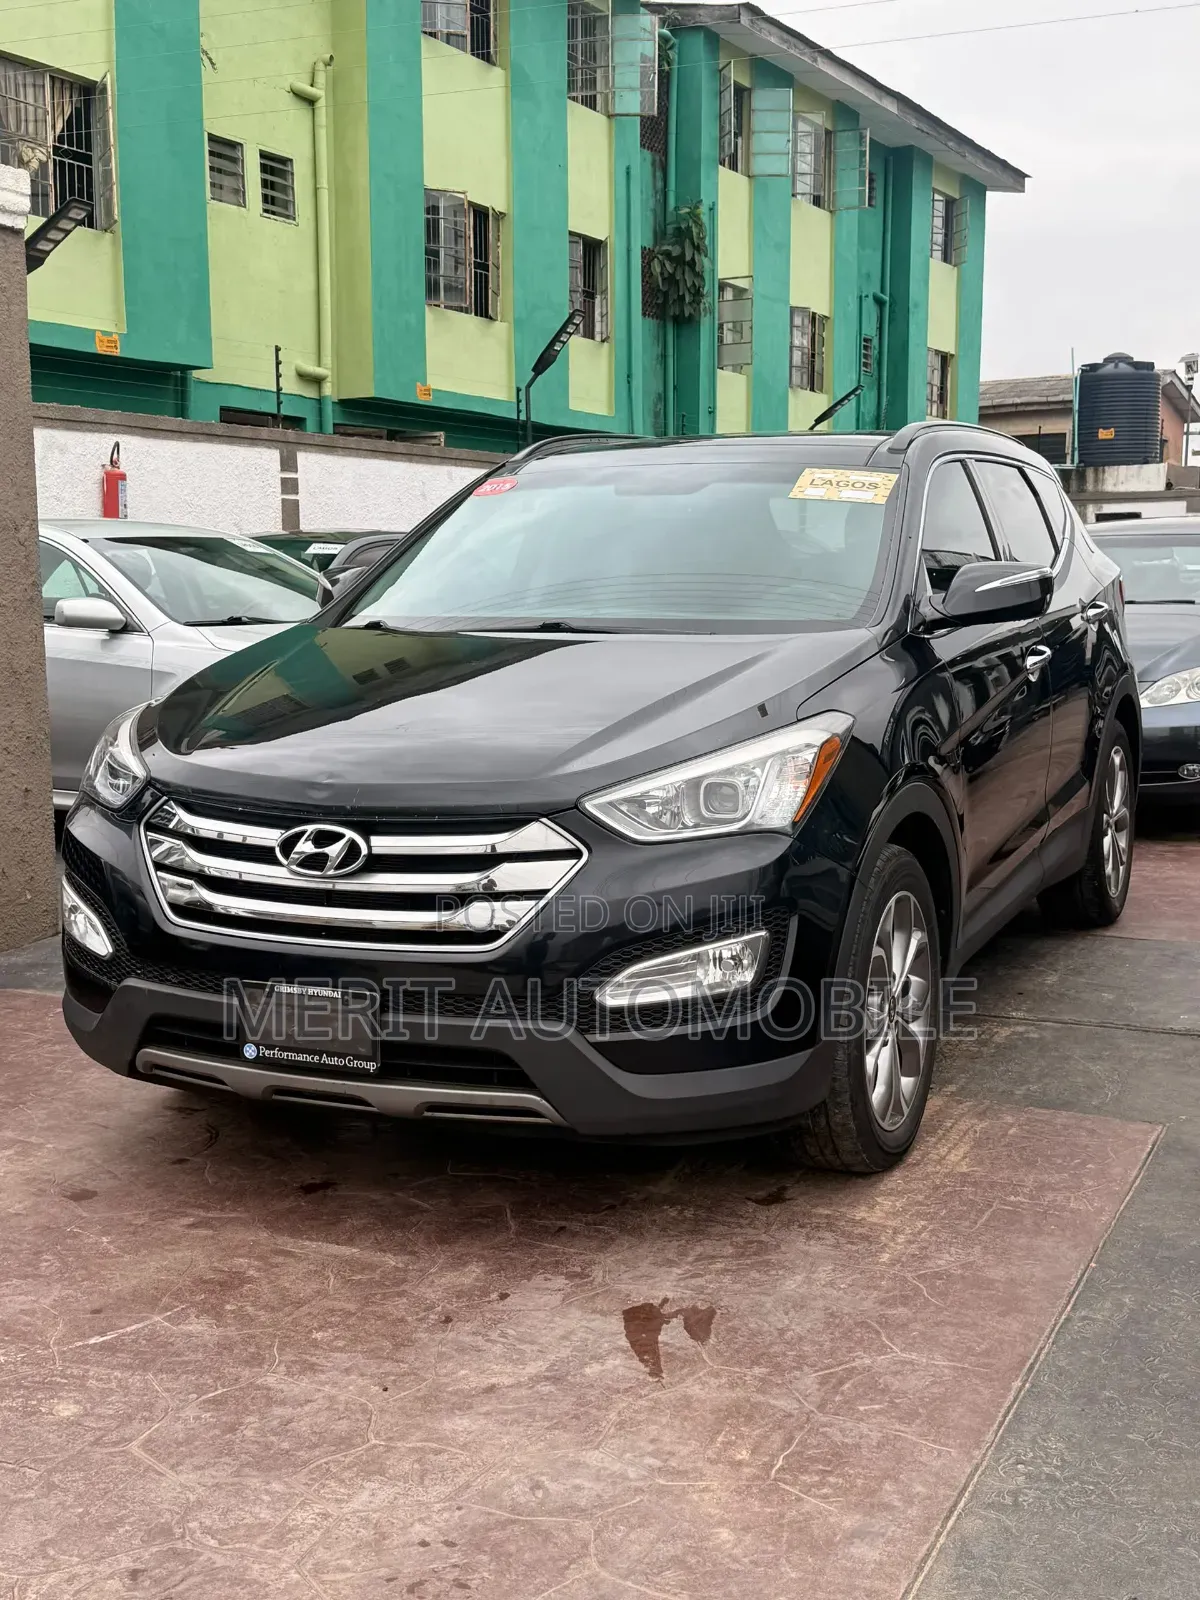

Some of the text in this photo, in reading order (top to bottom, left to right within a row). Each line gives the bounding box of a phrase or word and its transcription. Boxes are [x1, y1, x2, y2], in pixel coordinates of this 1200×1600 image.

[808, 478, 880, 490] LAGOS
[274, 985, 342, 999] GRIMSBY HYUNDAI
[259, 1045, 377, 1072] Performance Auto Group
